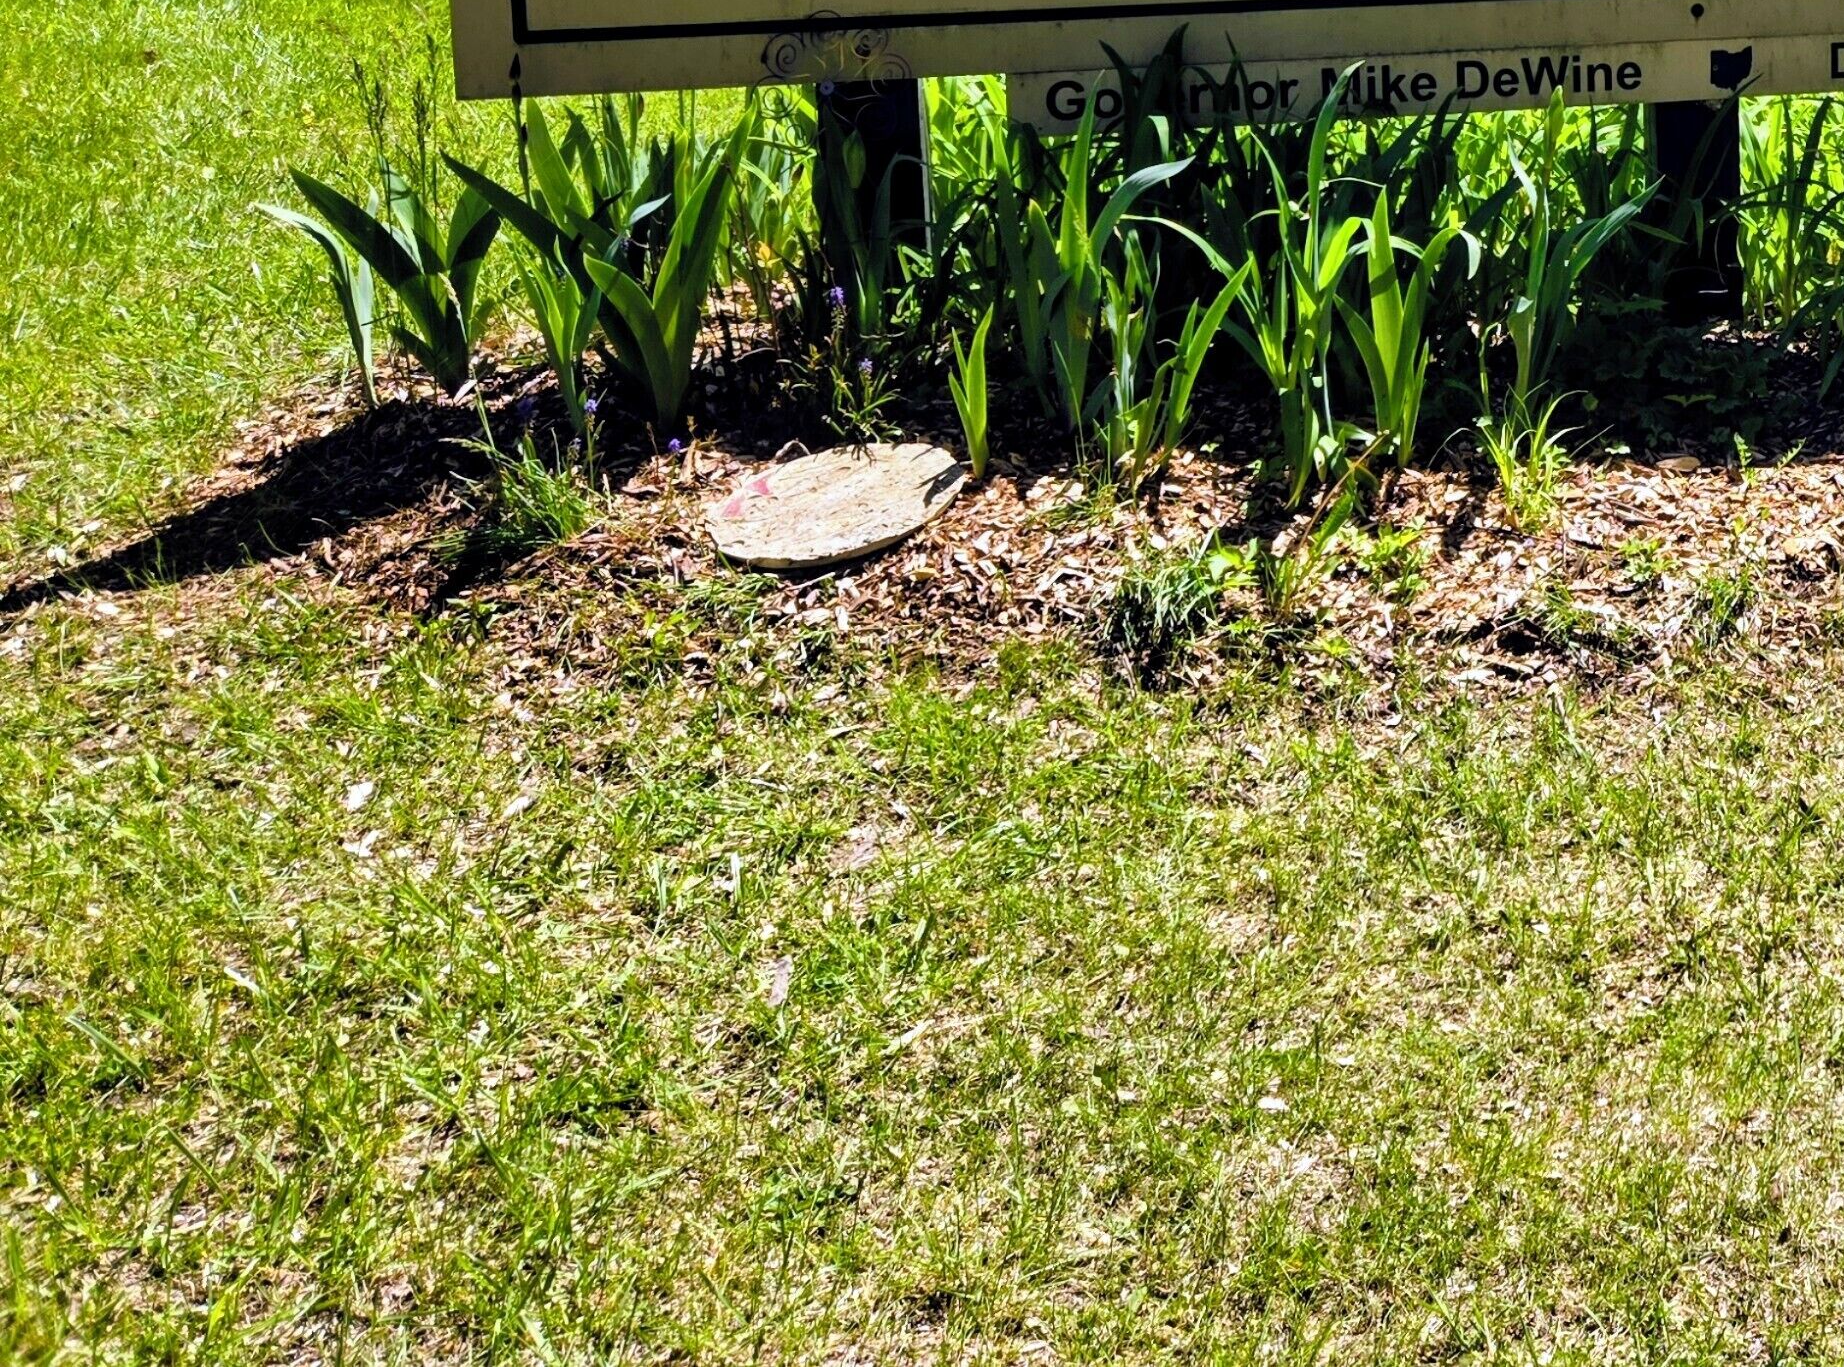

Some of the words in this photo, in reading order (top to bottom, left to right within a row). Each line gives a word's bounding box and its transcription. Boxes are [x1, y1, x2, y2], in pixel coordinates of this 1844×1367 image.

[1045, 78, 1299, 121] Gornor
[1321, 64, 1437, 105] Mike
[1456, 55, 1643, 98] DeWine
